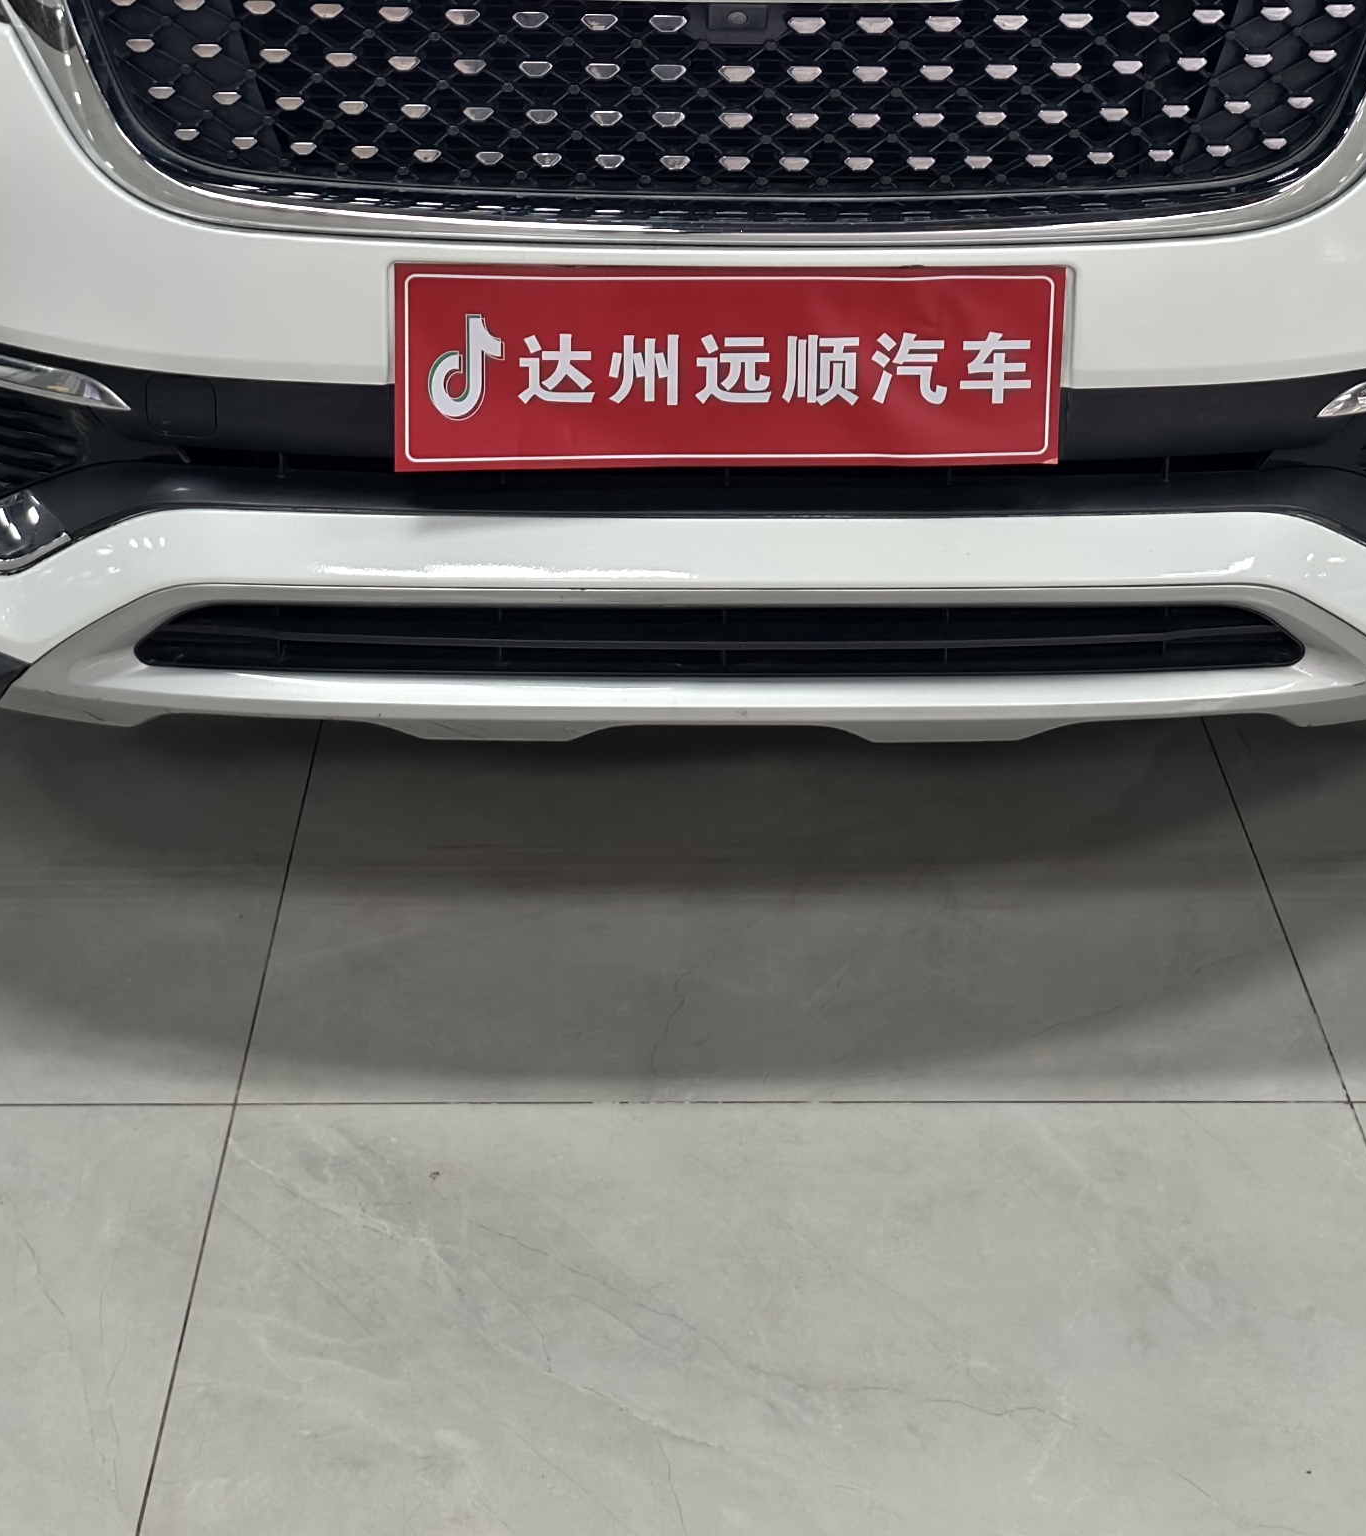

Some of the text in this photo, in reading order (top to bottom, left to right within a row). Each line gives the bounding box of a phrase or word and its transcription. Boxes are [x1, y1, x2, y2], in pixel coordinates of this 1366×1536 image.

[518, 332, 1033, 407] 达州远顺汽车
